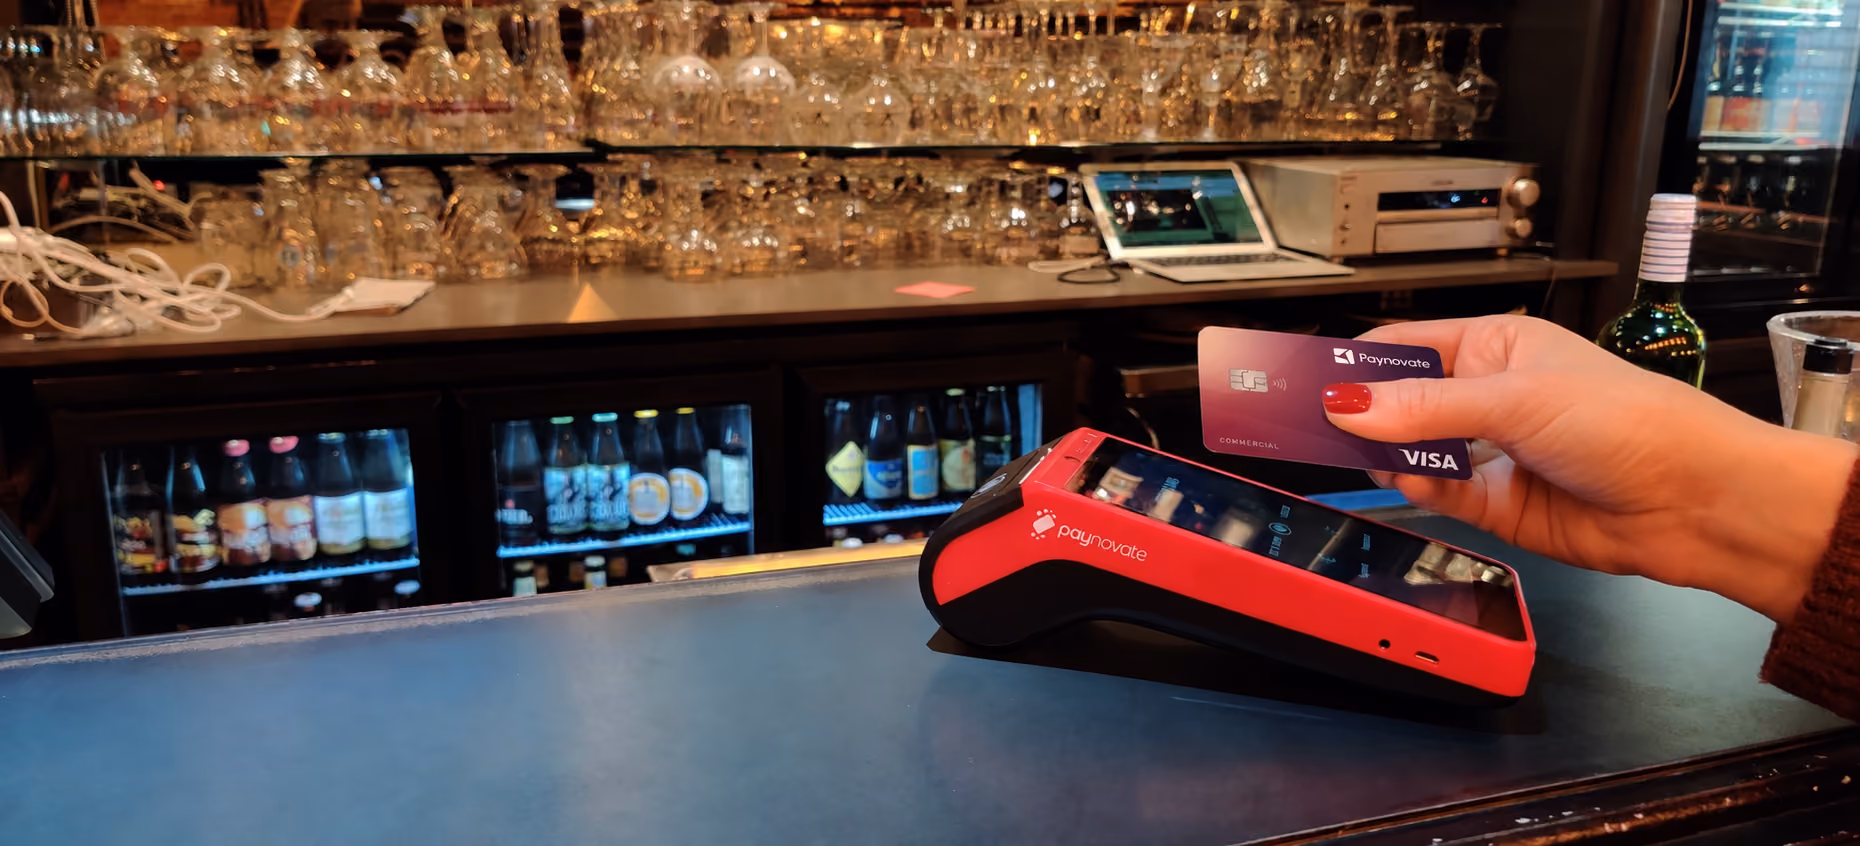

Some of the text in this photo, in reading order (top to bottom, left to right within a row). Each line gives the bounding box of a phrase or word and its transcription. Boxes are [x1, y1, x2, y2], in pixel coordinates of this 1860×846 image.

[1358, 353, 1431, 369] Paynovate
[1219, 437, 1280, 450] COMMERCIAL
[1398, 448, 1460, 471] VISA
[1057, 524, 1148, 562] paynovate
